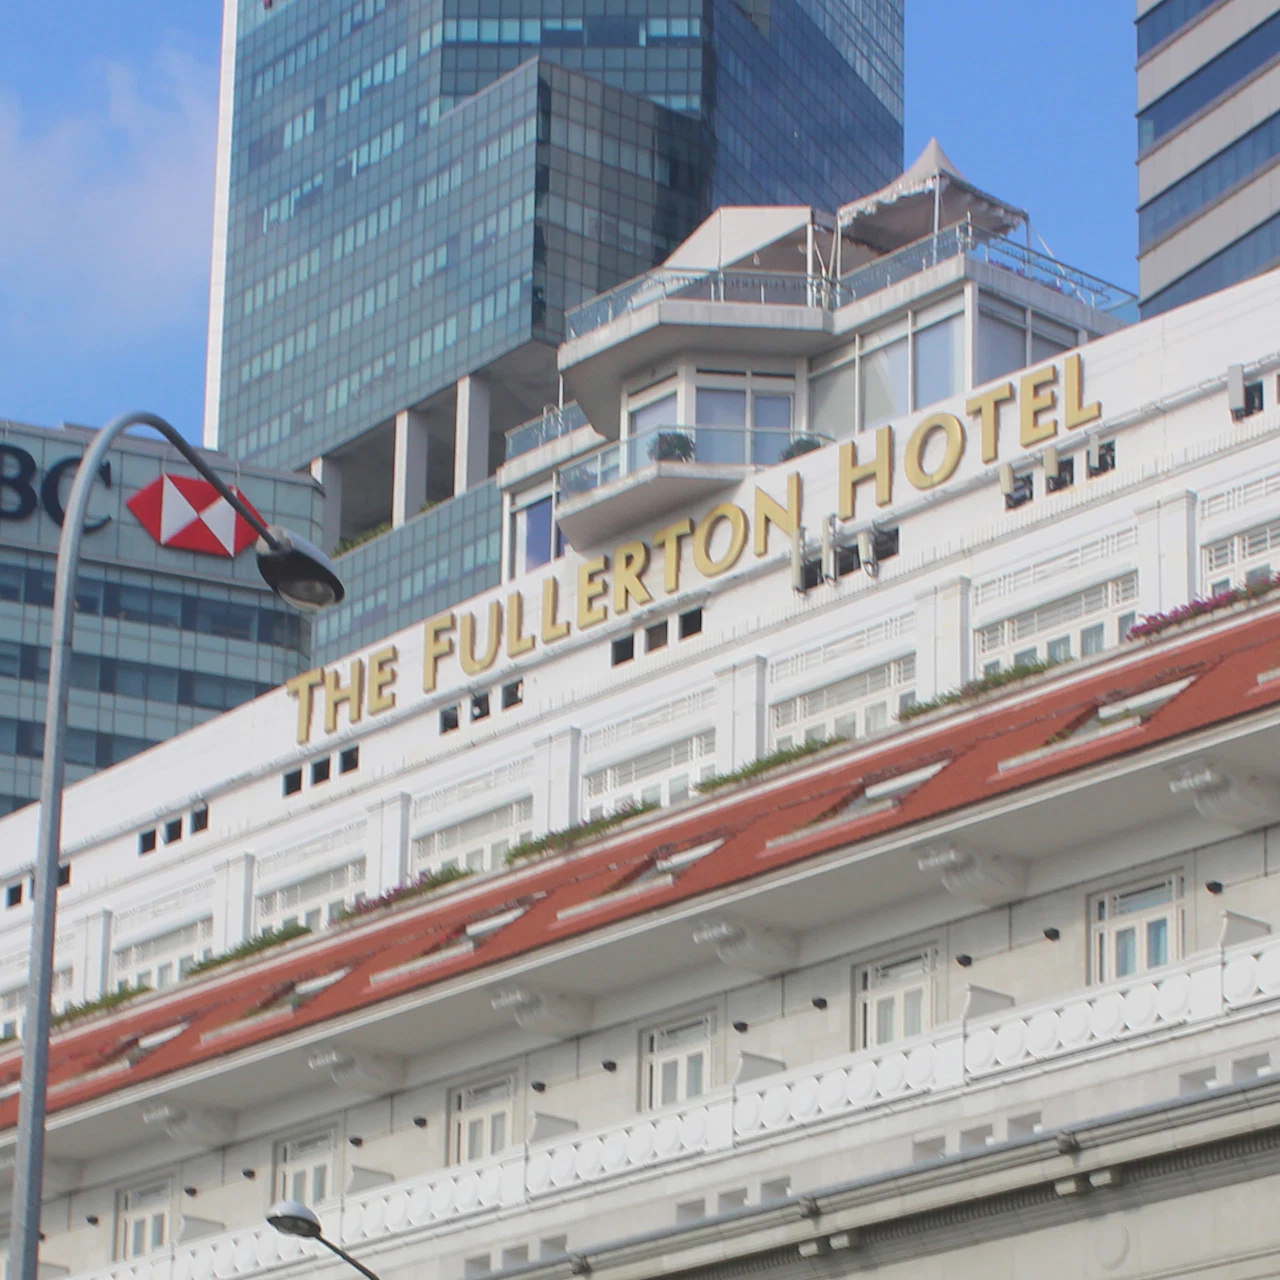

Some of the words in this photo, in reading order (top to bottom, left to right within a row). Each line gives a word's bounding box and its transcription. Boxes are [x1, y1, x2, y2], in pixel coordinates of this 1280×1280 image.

[286, 644, 399, 745] THE
[422, 470, 803, 694] FULLERTON
[837, 352, 1103, 522] HOTEL
